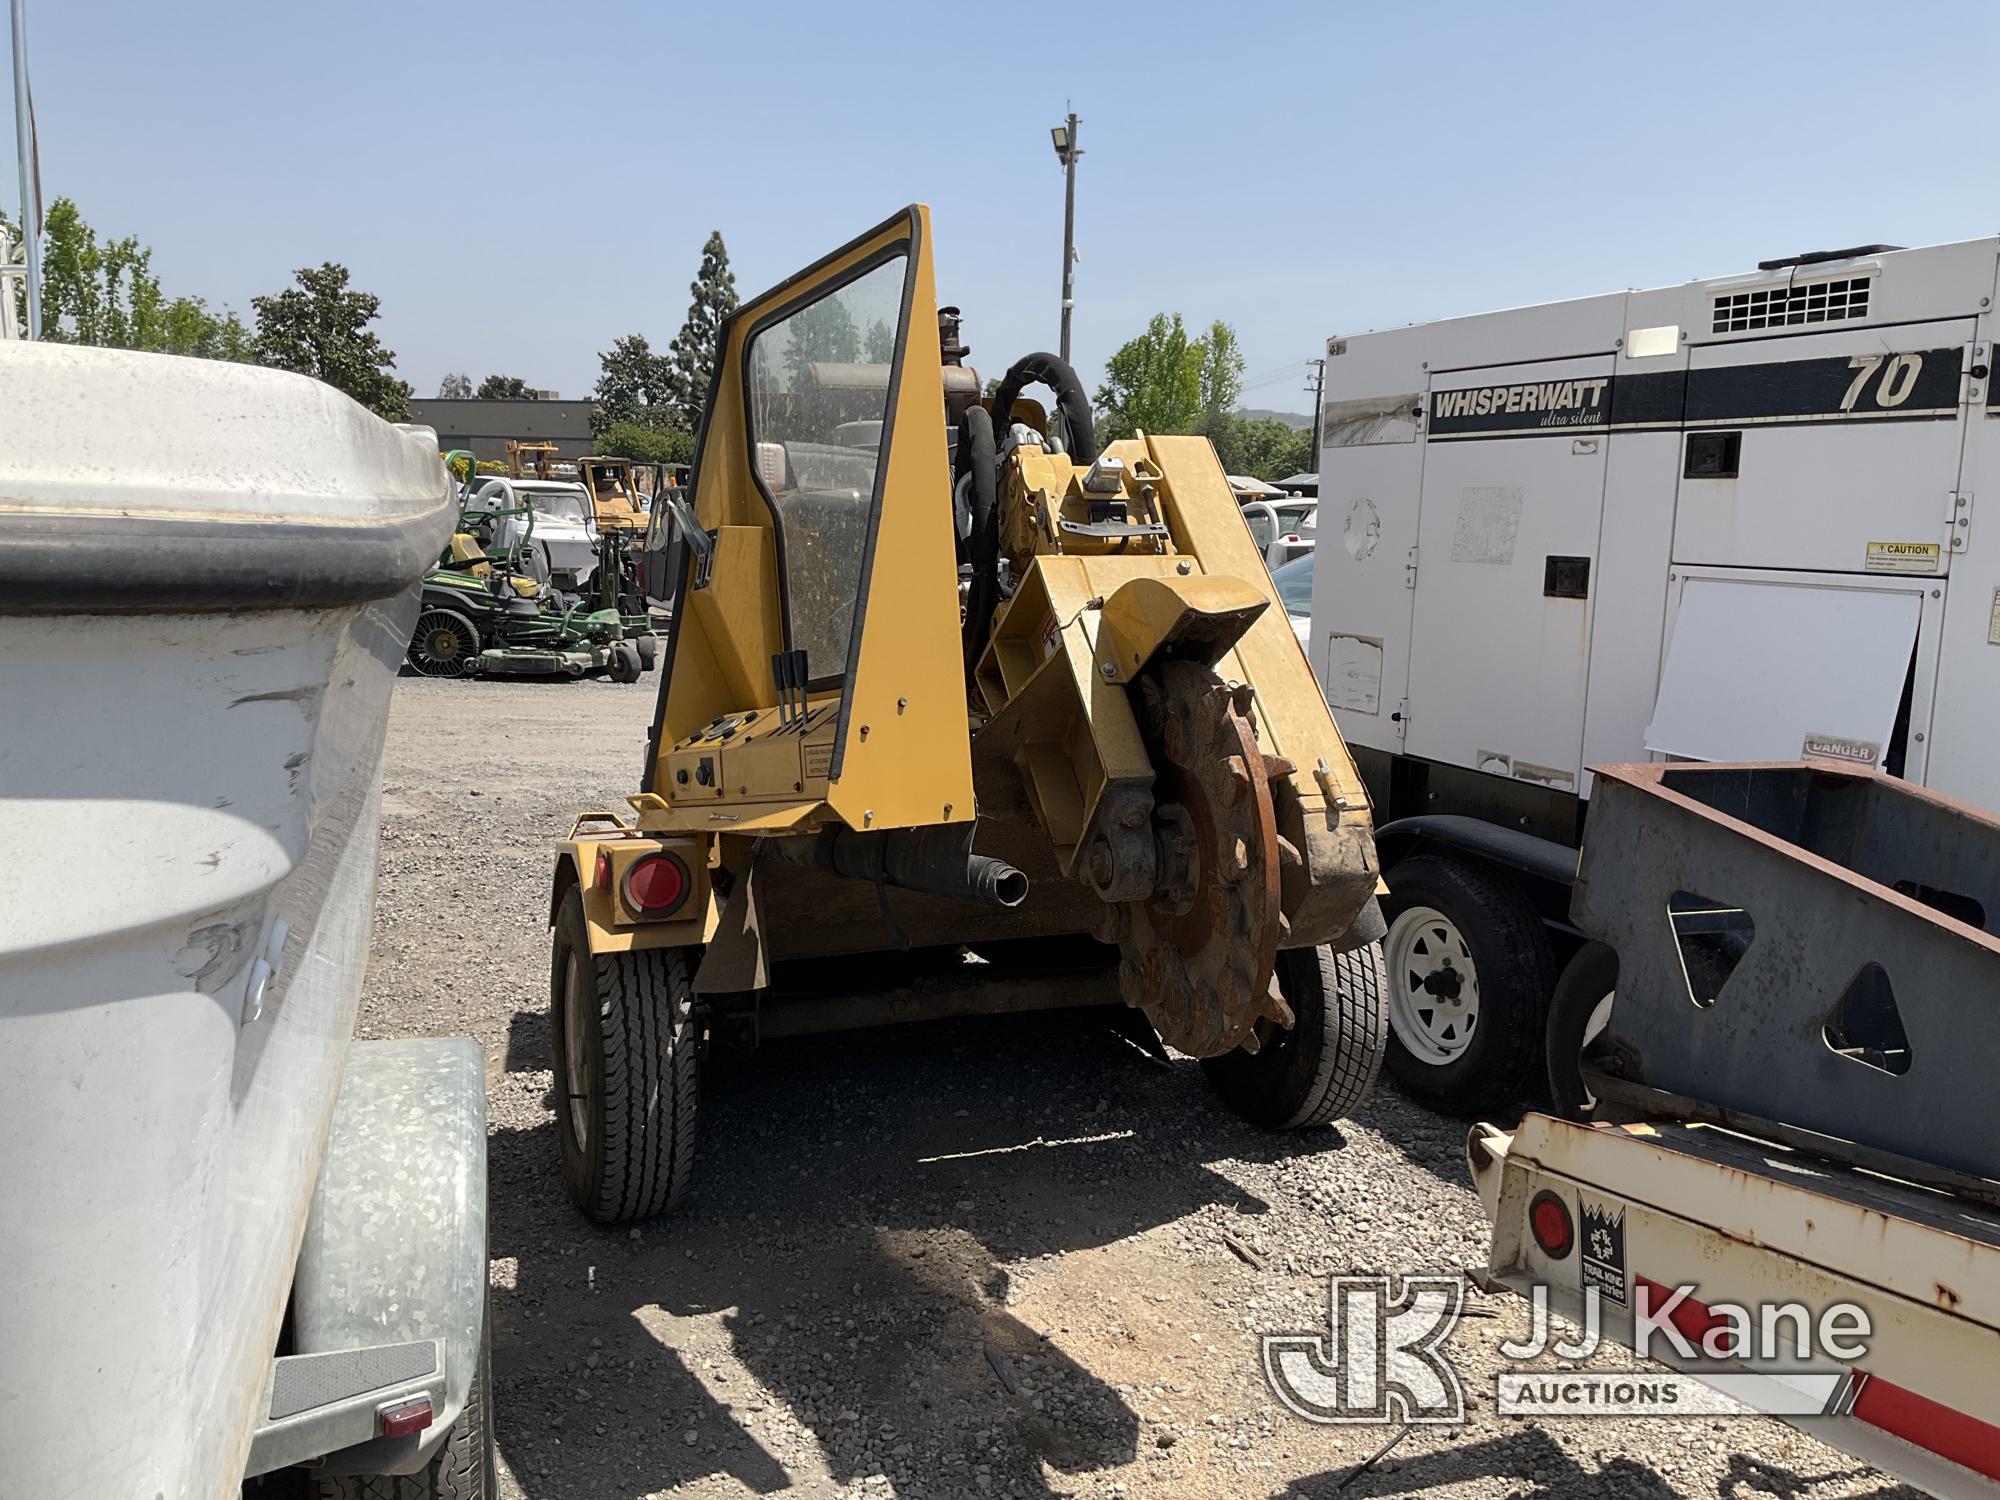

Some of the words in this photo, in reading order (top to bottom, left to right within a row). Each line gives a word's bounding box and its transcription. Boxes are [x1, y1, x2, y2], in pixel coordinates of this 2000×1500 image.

[1839, 353, 1923, 410] 70
[1436, 379, 1608, 418] WHISPERWATT
[1540, 411, 1569, 427] ultra
[1569, 408, 1602, 425] silent
[1887, 545, 1929, 555] CAUTION
[1812, 743, 1869, 759] DANGER
[1583, 1262, 1604, 1280] TRAIL
[1604, 1271, 1624, 1288] KING
